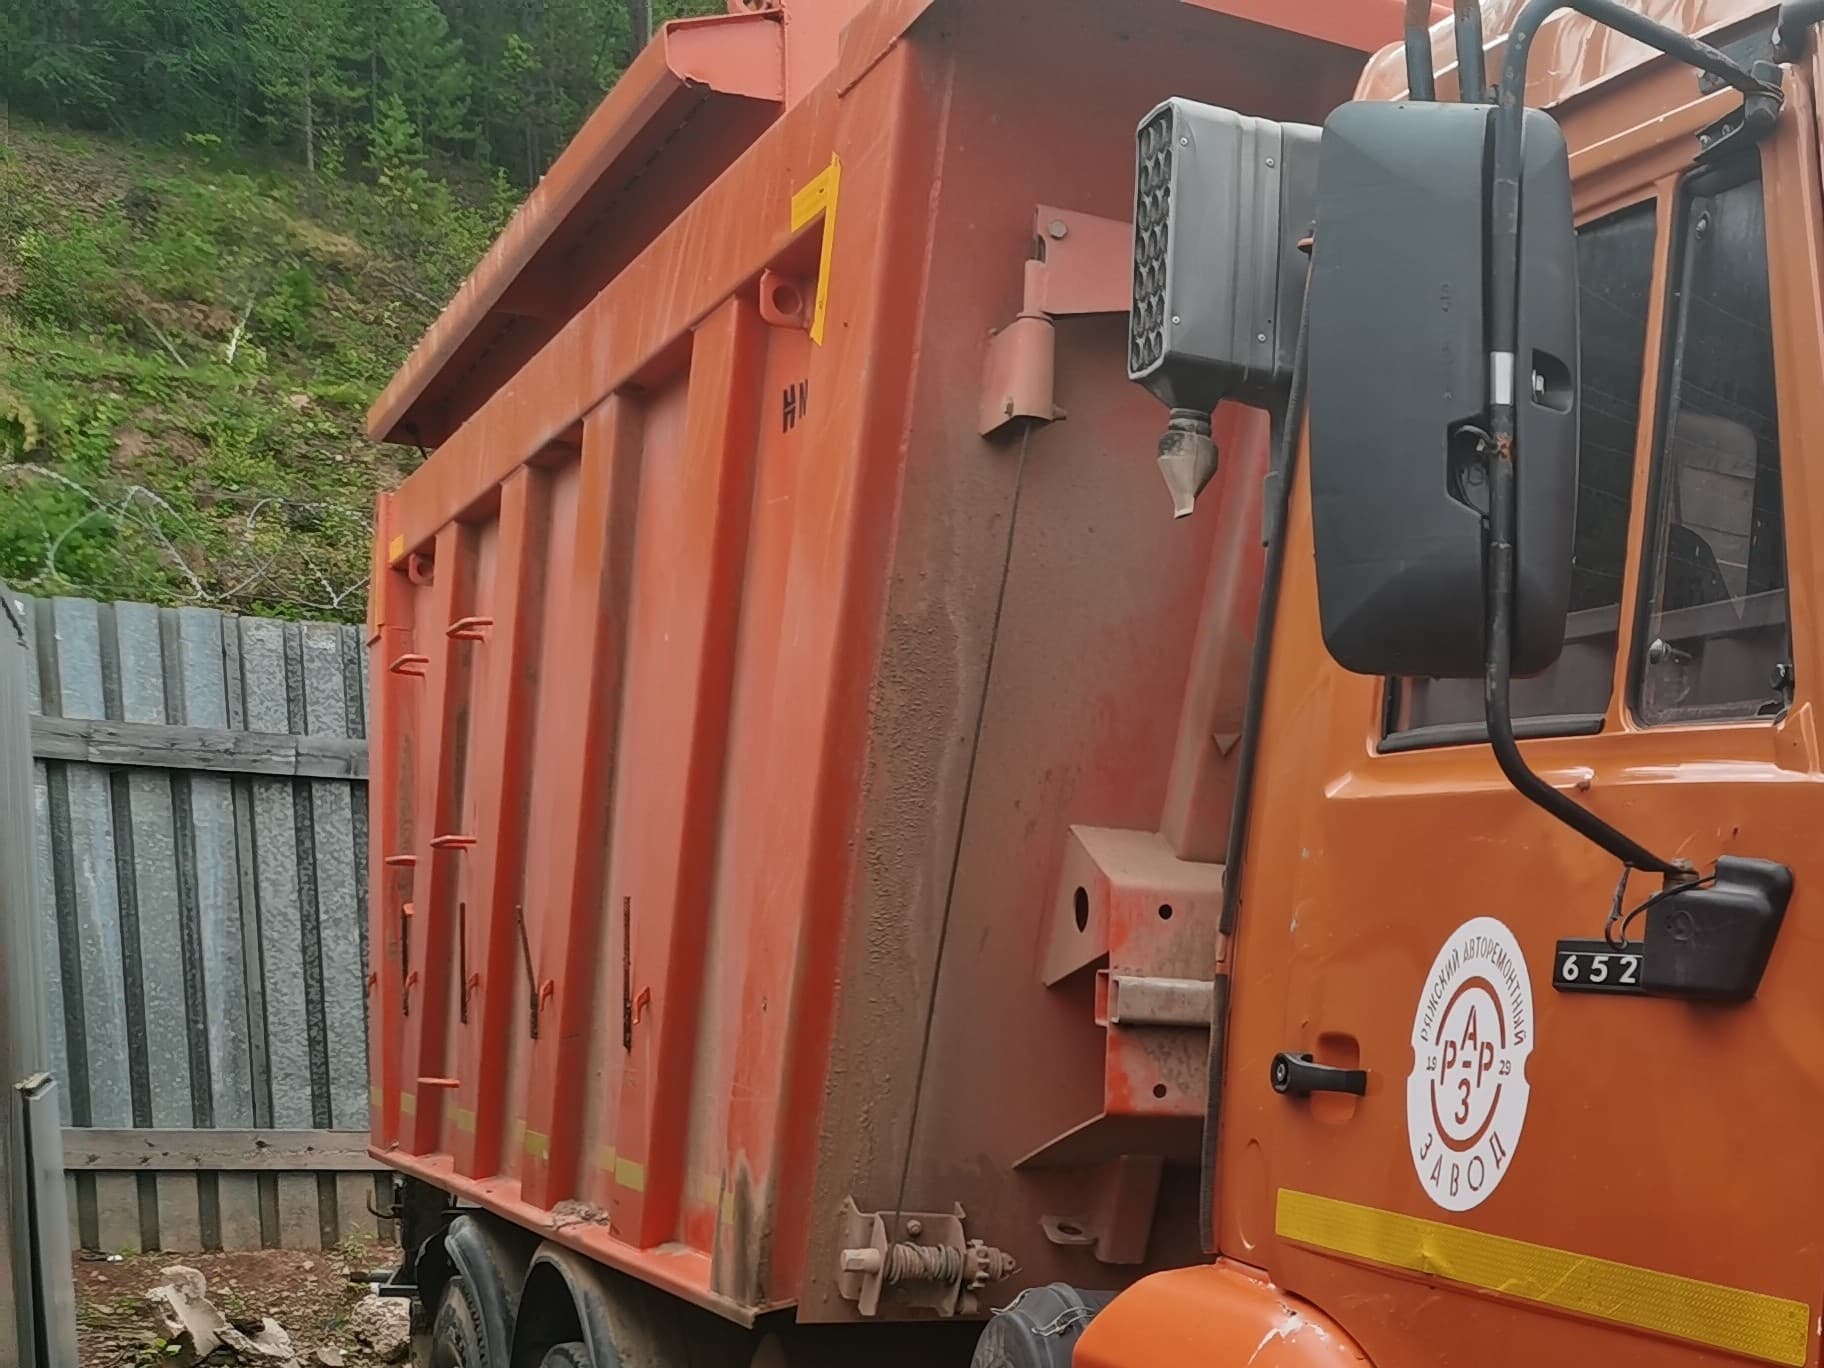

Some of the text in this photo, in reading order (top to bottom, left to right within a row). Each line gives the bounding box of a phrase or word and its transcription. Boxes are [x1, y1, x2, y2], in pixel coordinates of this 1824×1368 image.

[1420, 936, 1527, 1046] РЯЖСКИЙ АВТОРЕМОНТНЫЙ
[1426, 1056, 1437, 1071] 19
[1498, 1059, 1511, 1075] 29
[1420, 1131, 1506, 1197] ЗАВОД
